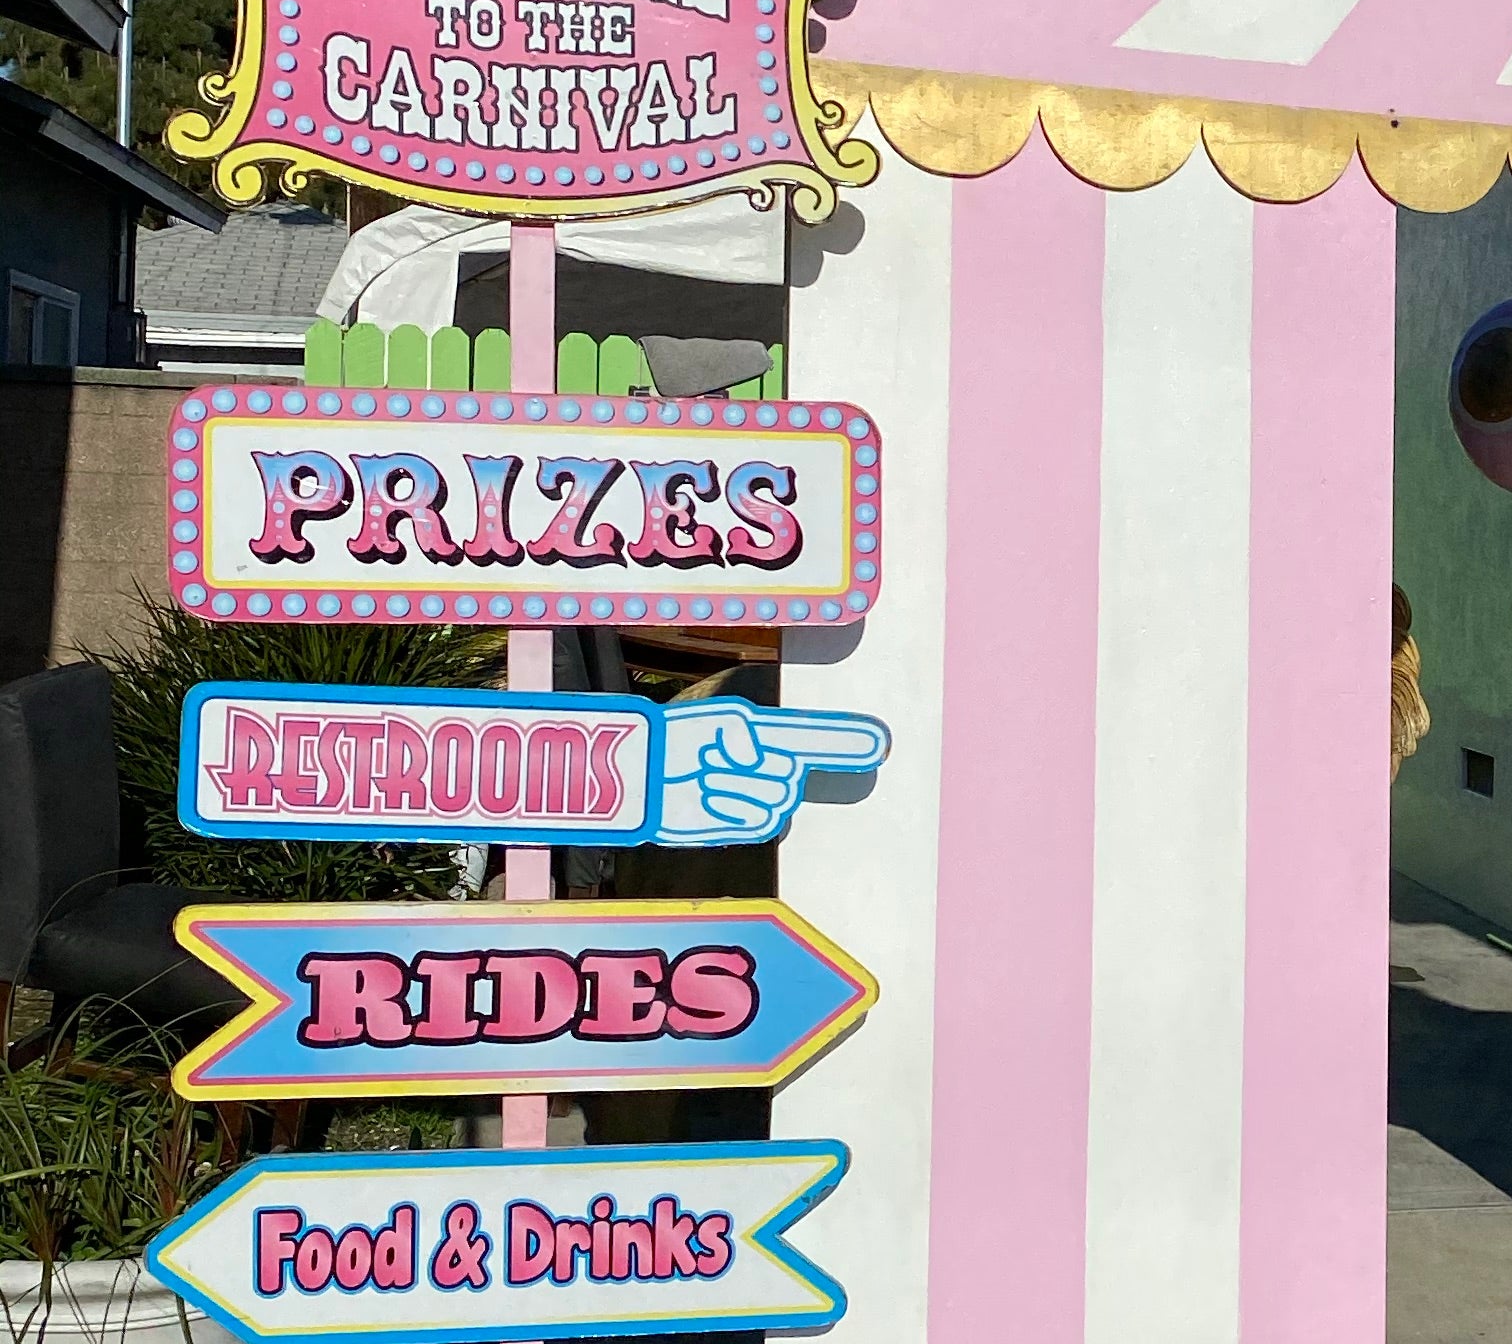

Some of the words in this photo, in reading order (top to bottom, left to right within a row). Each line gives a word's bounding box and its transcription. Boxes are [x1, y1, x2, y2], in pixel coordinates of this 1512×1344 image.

[322, 32, 738, 152] CARNIVAL
[249, 451, 804, 570] PRIZES
[204, 707, 636, 820] RESTROOMS
[298, 946, 758, 1047] RIDES
[254, 1202, 420, 1297] Food
[427, 1201, 492, 1291] &
[507, 1193, 734, 1287] Drinks
